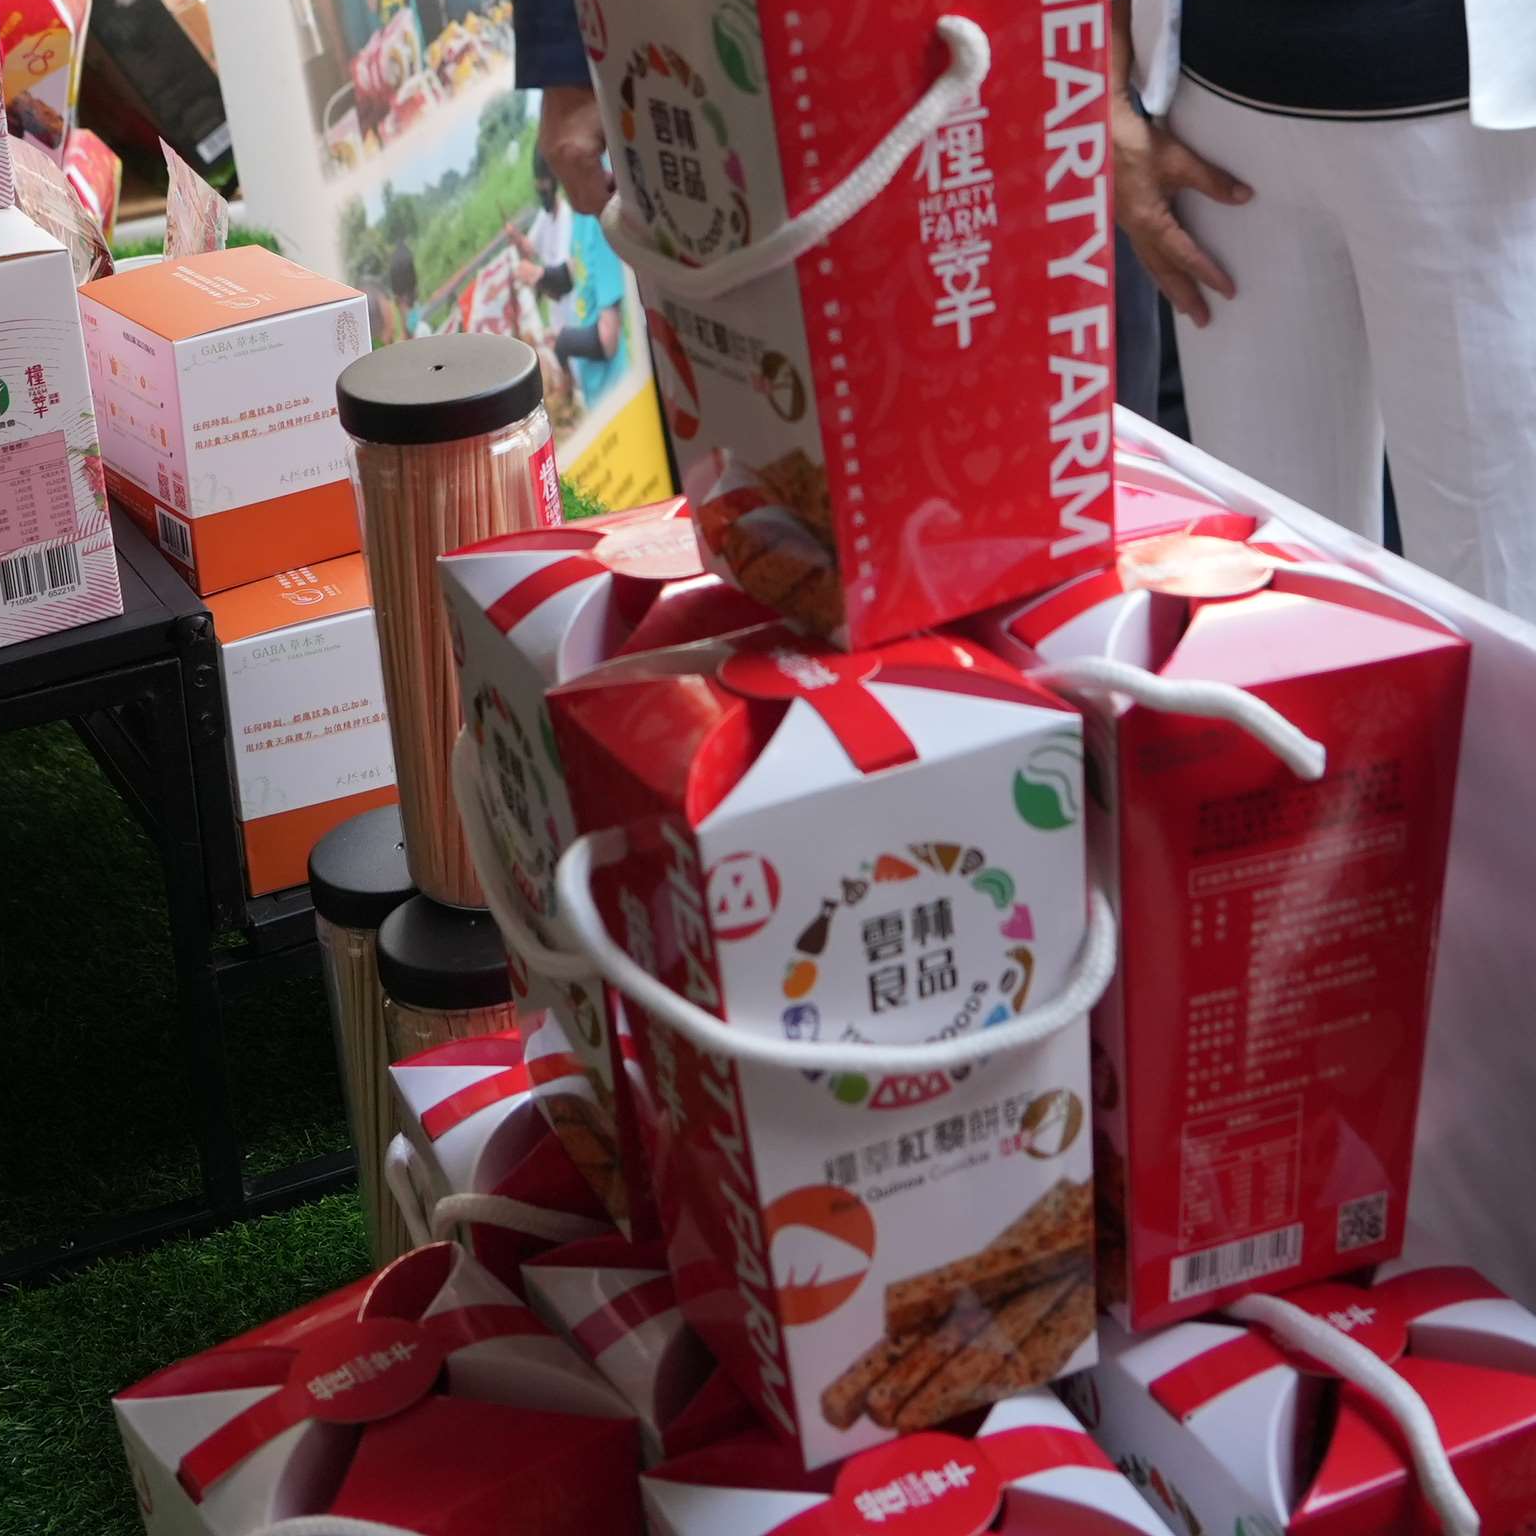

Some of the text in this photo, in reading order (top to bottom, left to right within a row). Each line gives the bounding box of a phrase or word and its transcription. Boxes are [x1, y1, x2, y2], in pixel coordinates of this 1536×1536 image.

[917, 182, 996, 216] HEARTY
[919, 203, 999, 245] FARM
[200, 341, 233, 356] GABA
[1048, 304, 1112, 560] FARM
[10, 595, 38, 607] 710958
[48, 585, 76, 598] 652218
[252, 643, 287, 660] GABA
[862, 896, 955, 963] 雲林
[868, 948, 959, 1015] 良品
